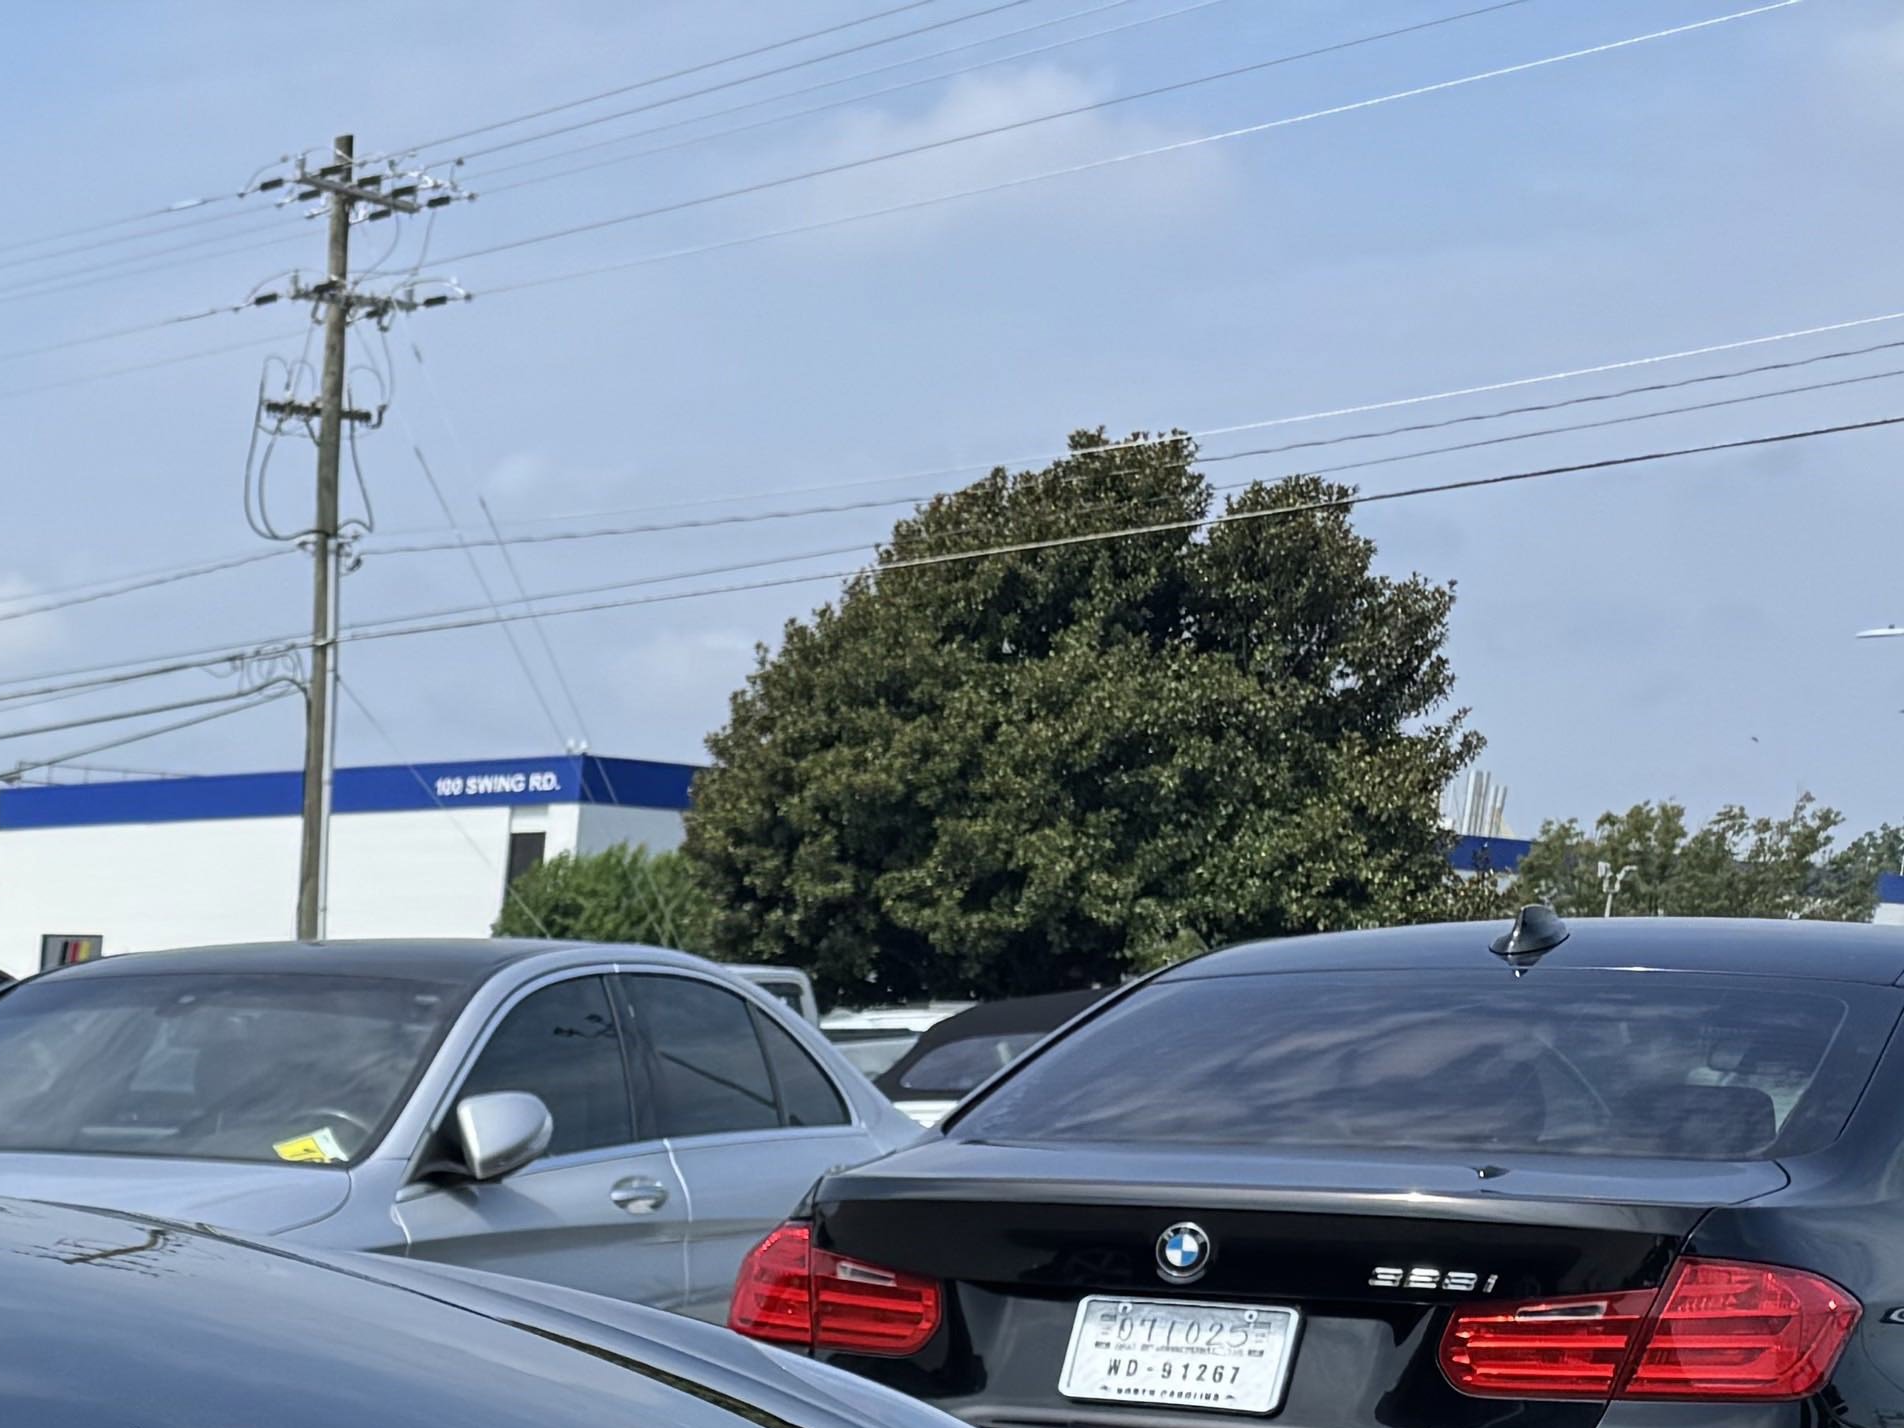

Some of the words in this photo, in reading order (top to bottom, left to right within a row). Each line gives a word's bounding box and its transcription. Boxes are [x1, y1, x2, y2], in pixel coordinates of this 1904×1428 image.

[435, 776, 464, 797] 100
[465, 773, 526, 795] SWING
[528, 771, 561, 792] RD.
[1368, 1267, 1498, 1293] 328i
